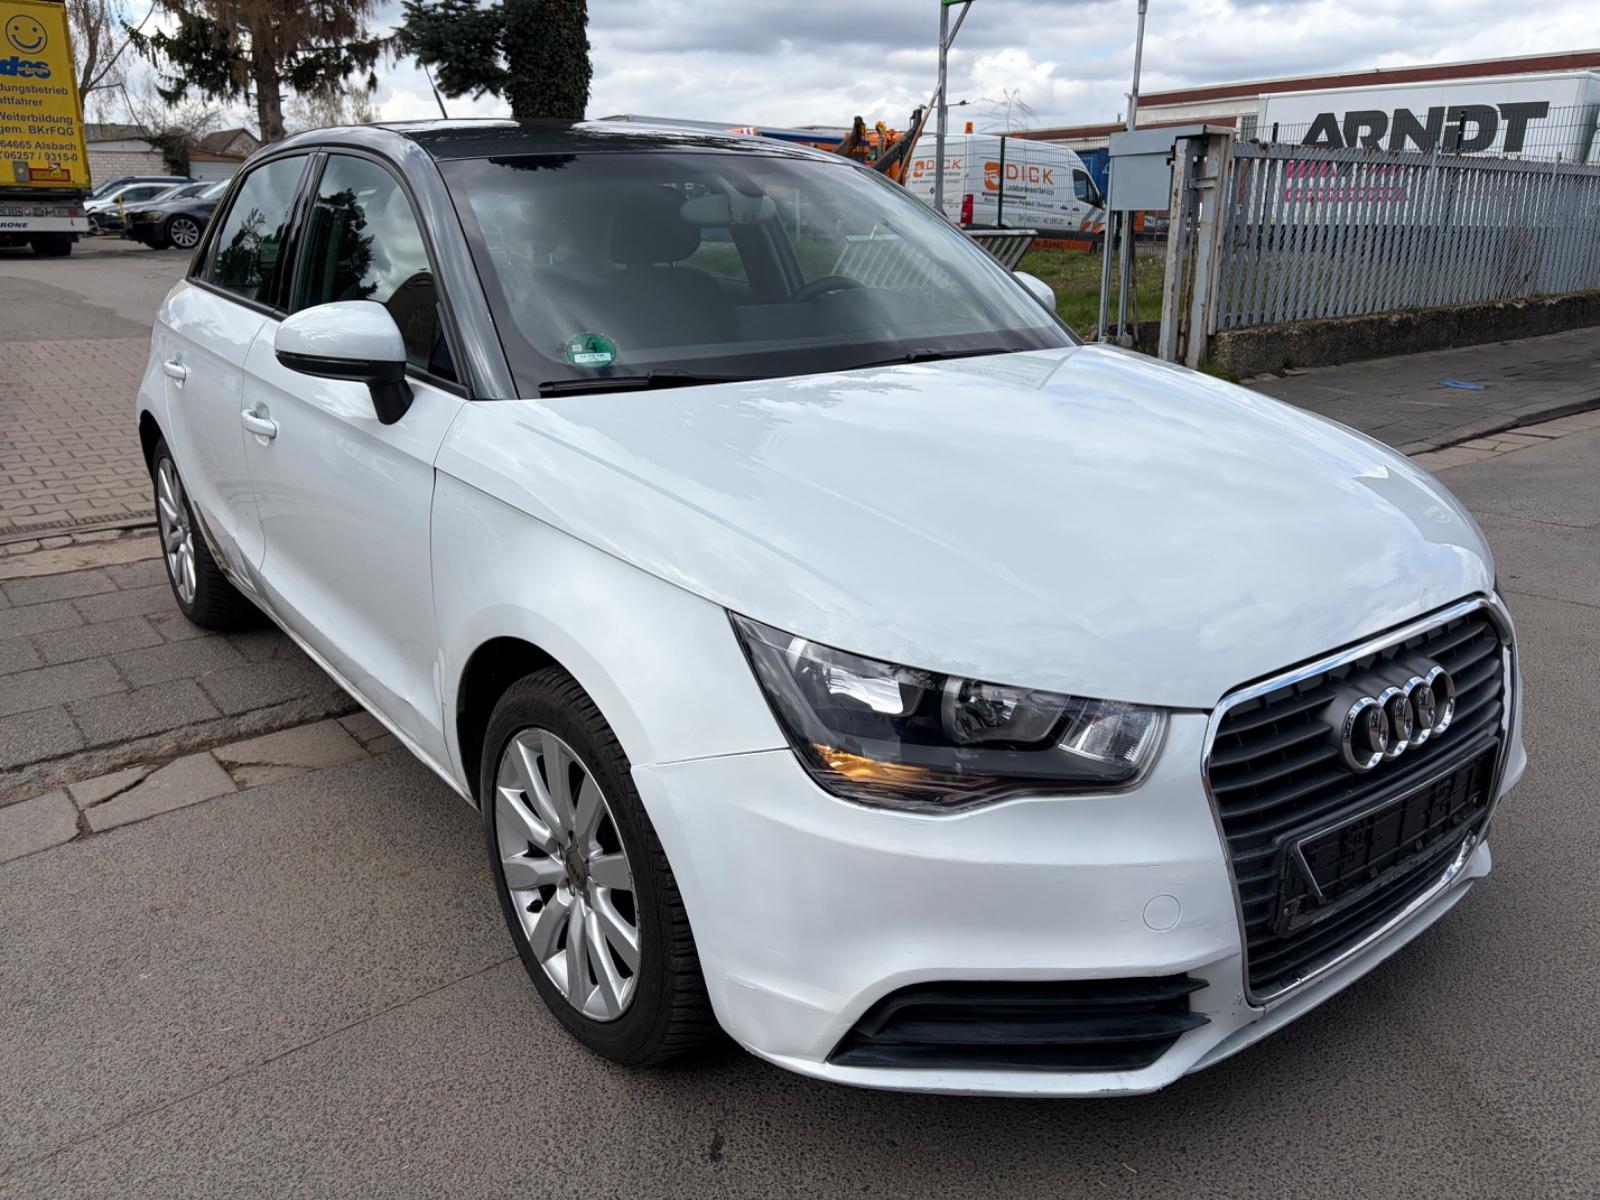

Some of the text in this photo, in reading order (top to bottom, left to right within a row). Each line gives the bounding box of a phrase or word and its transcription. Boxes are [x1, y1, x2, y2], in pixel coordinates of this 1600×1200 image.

[29, 125, 74, 136] BKrFQG
[1301, 101, 1550, 154] ARNDT
[35, 141, 77, 151] Alsbach
[926, 159, 961, 170] DCK
[1006, 163, 1054, 185] DICK
[585, 336, 598, 351] 4
